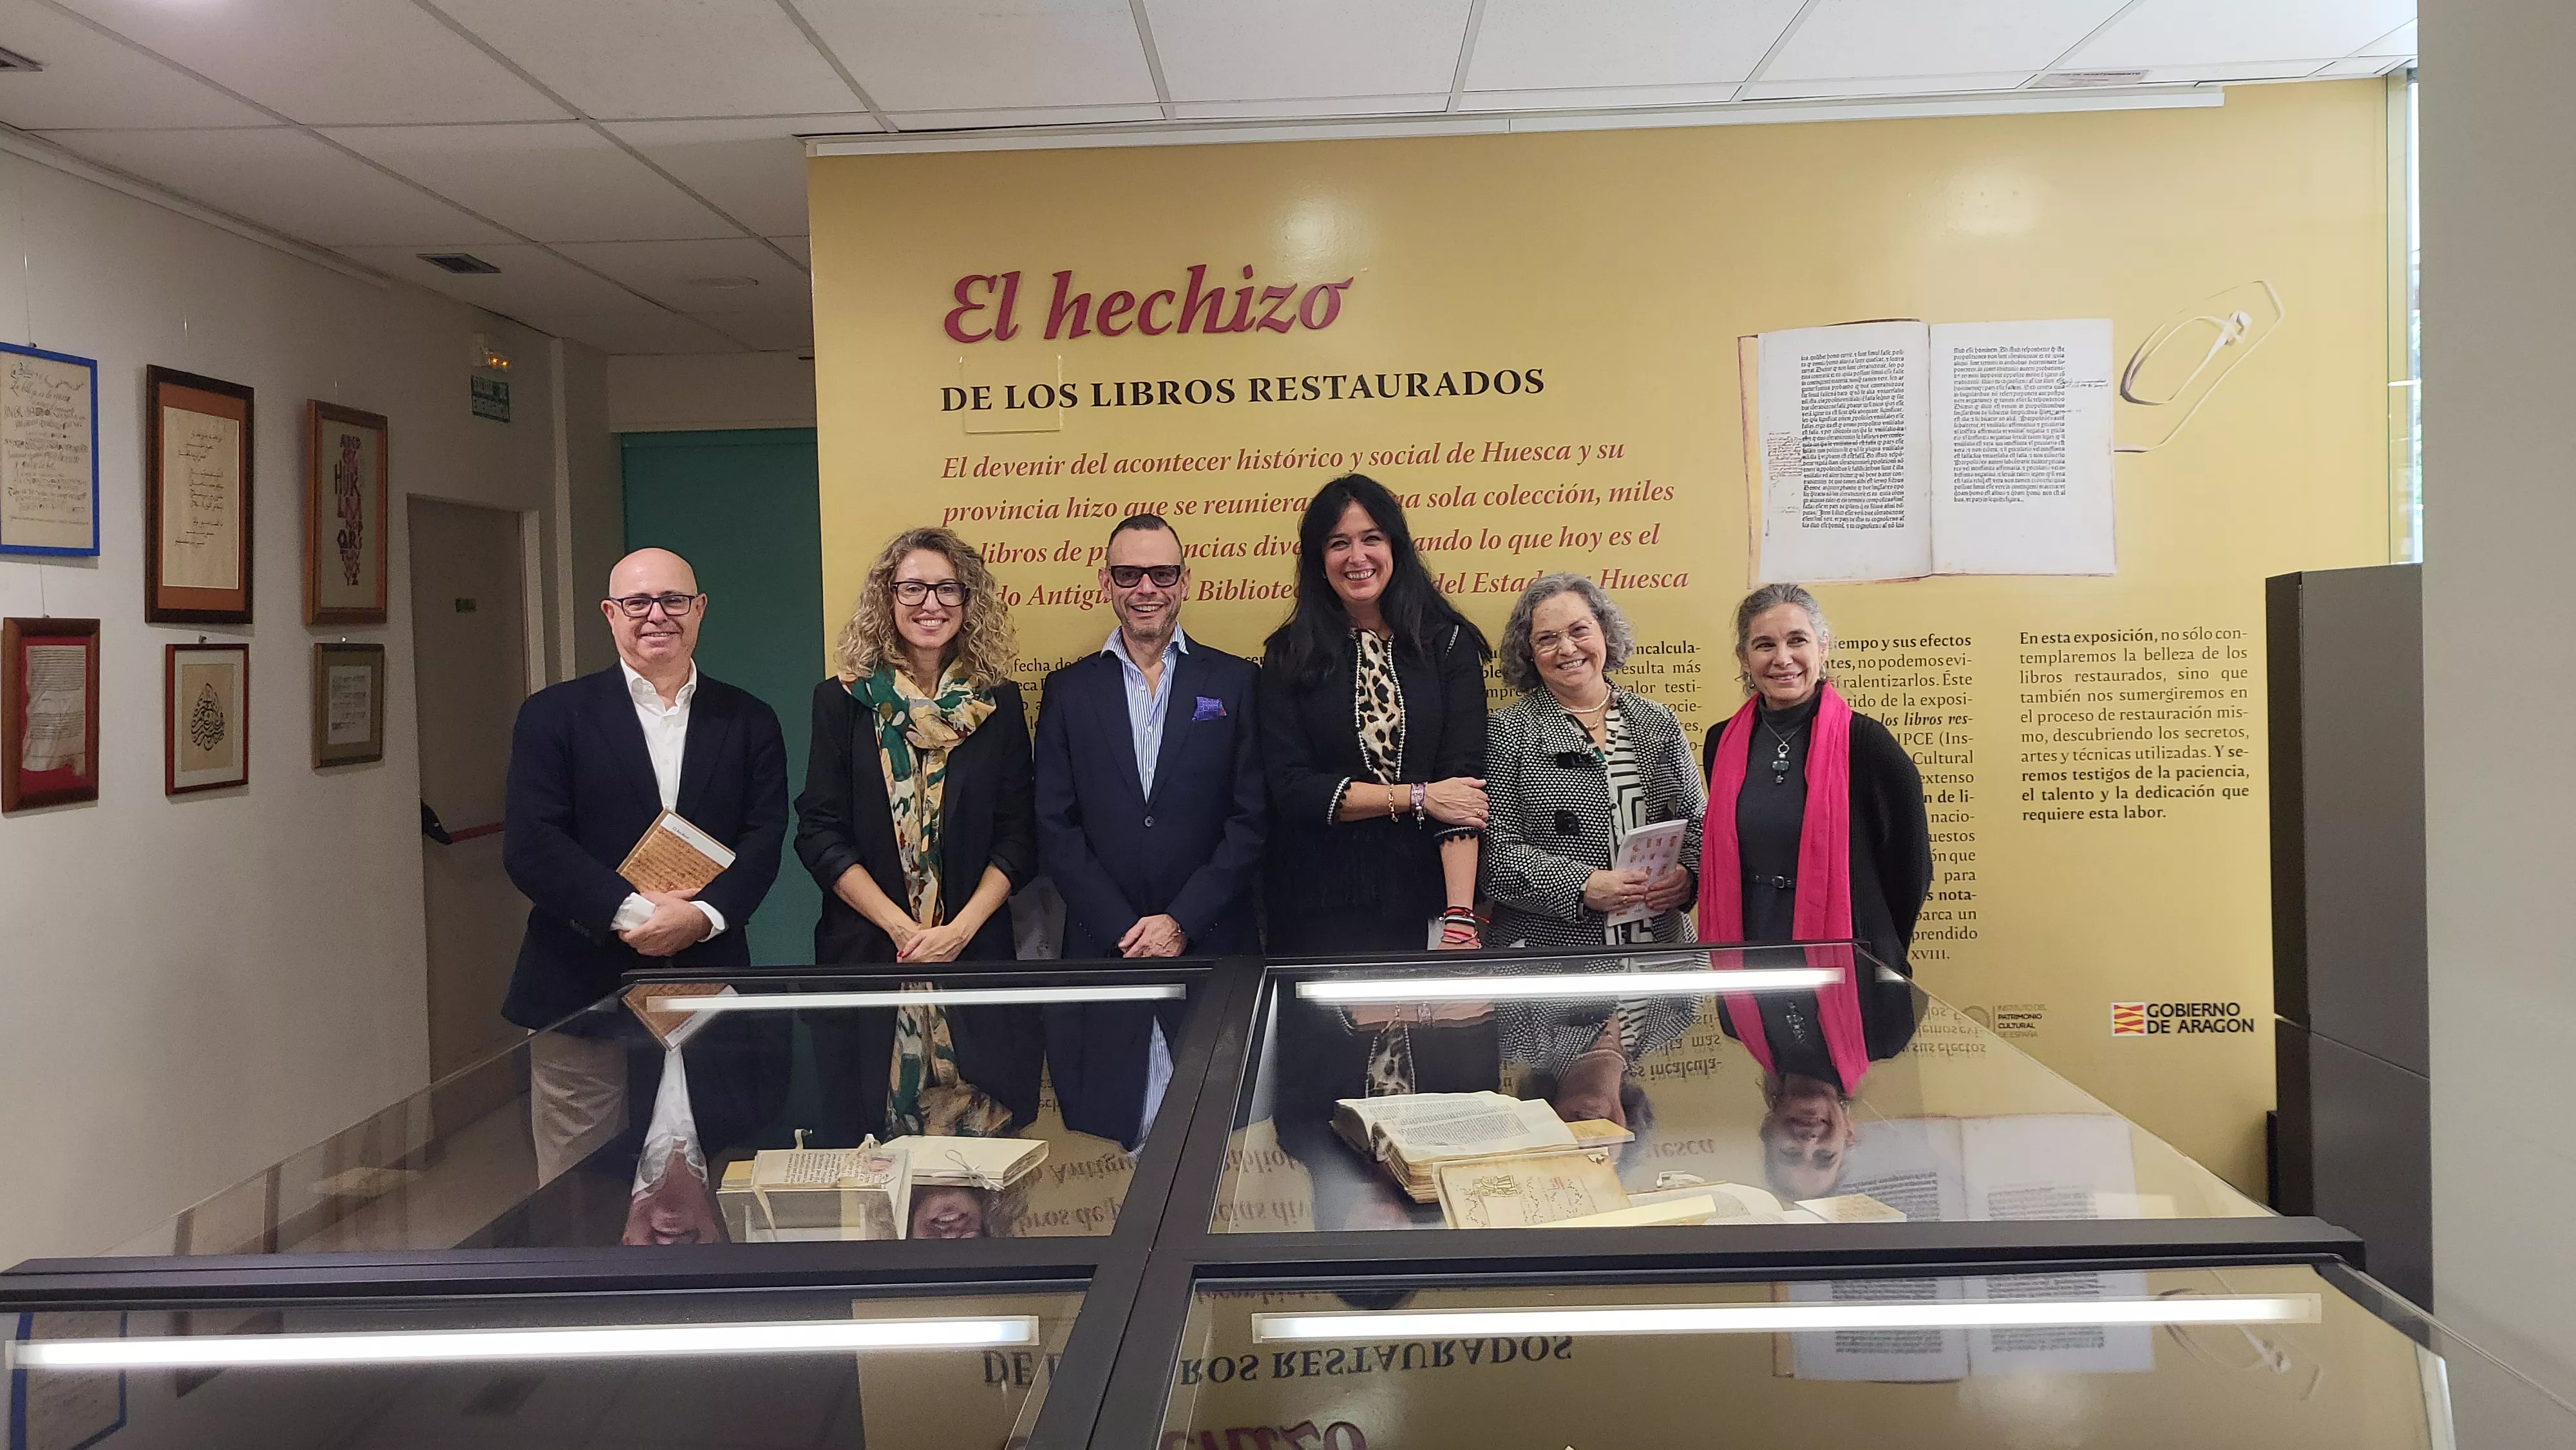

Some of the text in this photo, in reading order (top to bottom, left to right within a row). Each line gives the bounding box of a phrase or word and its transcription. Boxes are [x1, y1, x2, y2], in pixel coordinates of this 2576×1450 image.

[943, 263, 1354, 344] El hechizo
[940, 368, 1544, 411] DE LOS LIBROS RESTAURADOS
[940, 441, 1624, 478] El devenir del acontecer histórico y social de Huesca y su
[941, 479, 1674, 528] provincia hizo que se reuniera sola colección, miles
[1053, 540, 1083, 562] de
[1184, 537, 1247, 558] ncias
[1413, 529, 1472, 551] ando
[1479, 528, 1502, 550] lo
[1508, 533, 1553, 555] que
[1558, 525, 1603, 553] hoy
[1609, 531, 1633, 546] es
[1638, 523, 1661, 545] el
[1026, 584, 1111, 610] Antigu
[1470, 570, 1543, 593] Estad
[1600, 569, 1689, 589] Huesca
[1880, 639, 1890, 652] y
[1892, 638, 1917, 648] sus
[1920, 633, 1971, 647] efectos
[2020, 626, 2248, 646] En esta exposición, no sólo con-
[1633, 641, 1701, 654] ncalcula-
[2020, 645, 2248, 666] templaremos la belleza de los
[1014, 657, 1051, 672] fecha
[1672, 659, 1701, 673] más
[1858, 659, 1876, 668] no
[1878, 654, 1944, 671] podemos
[1946, 652, 1972, 666] evi-
[1843, 672, 1939, 688] ralentizarlos.
[1942, 670, 1973, 686] Éste
[2020, 666, 2248, 684] libros restaurados, sino que
[1665, 679, 1701, 693] testi-
[1847, 692, 1973, 709] tido de la exposi-
[2020, 686, 2248, 704] también nos sumergiremos en
[1663, 699, 1702, 711] ocie-
[1904, 711, 1943, 726] libros
[1948, 715, 1973, 725] res-
[2021, 704, 2248, 726] el proceso de restauración mis-
[1939, 731, 1973, 747] (Ins-
[2021, 726, 2249, 744] mo, descubriendo los secretos,
[1913, 750, 1974, 765] Cultural
[2021, 744, 2249, 765] artes y técnicas utilizadas. Y se-
[1920, 773, 1975, 784] extenso
[2022, 764, 2249, 783] remos testigos de la paciencia,
[1937, 789, 1955, 803] de
[1959, 789, 1975, 803] li-
[2022, 784, 2249, 803] el talento y la dedicación que
[1931, 809, 1975, 823] nacio-
[2022, 804, 2166, 824] requiere esta labor.
[1929, 832, 1975, 843] uestos
[1949, 852, 1976, 865] que
[1944, 871, 1976, 885] para
[1938, 890, 1976, 901] nota-
[1958, 910, 1976, 920] un
[1912, 926, 1978, 943] prendido
[1911, 949, 1950, 960] XVIII.
[2146, 1002, 2240, 1018] GOBIERNO
[2147, 1018, 2255, 1034] DE ARAGON
